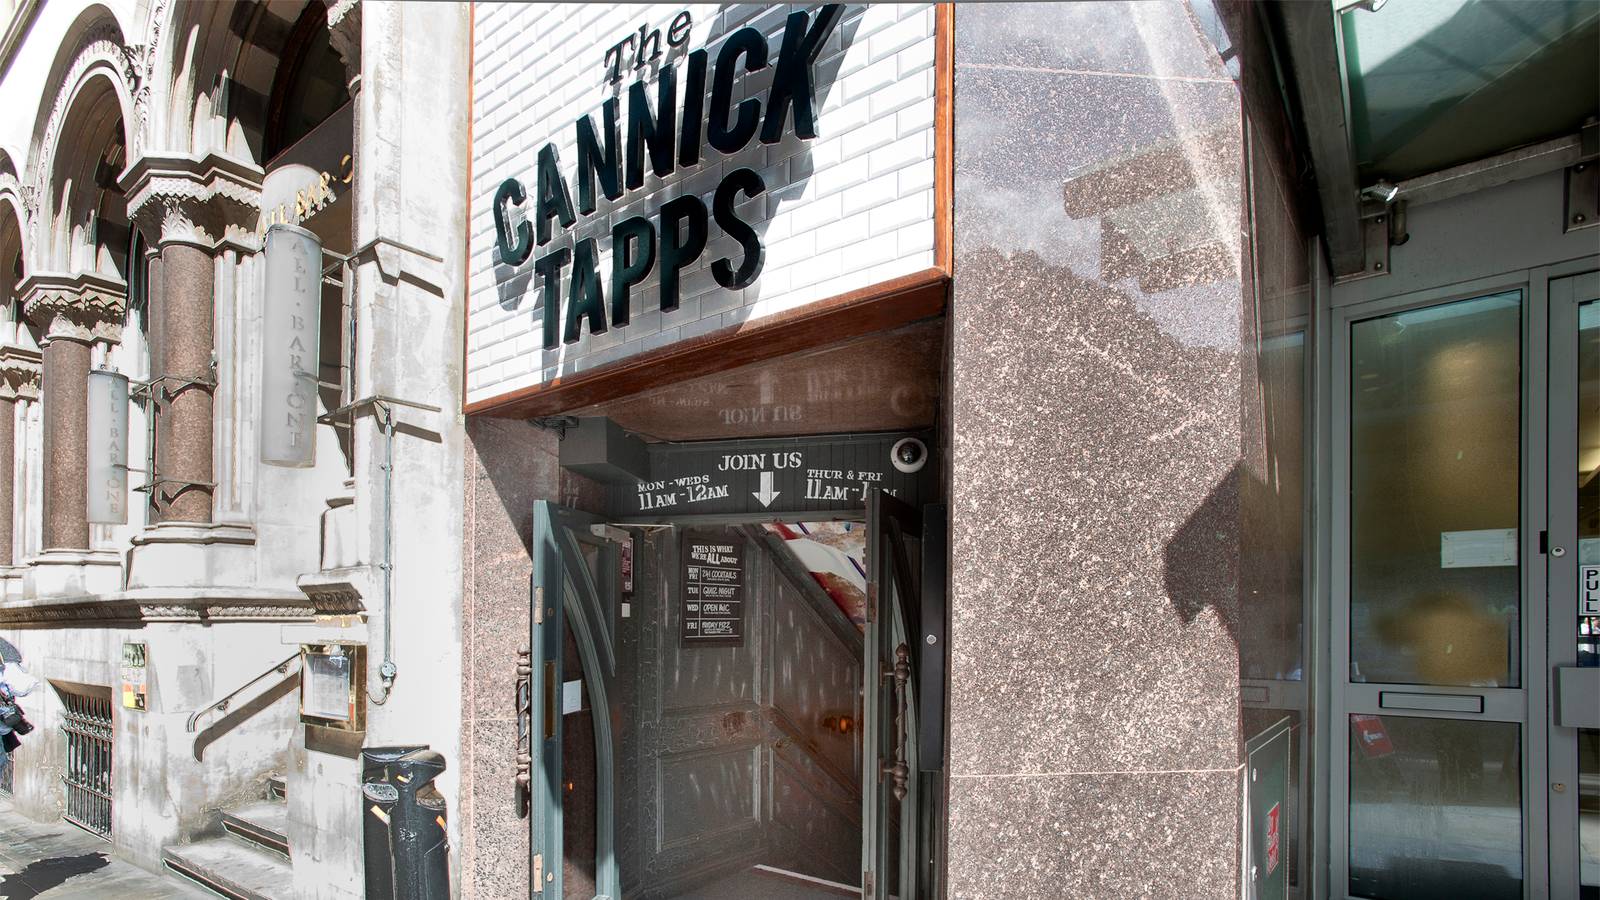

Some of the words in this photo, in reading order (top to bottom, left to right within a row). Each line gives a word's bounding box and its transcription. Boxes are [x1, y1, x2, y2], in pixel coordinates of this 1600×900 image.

[604, 10, 693, 86] The
[493, 3, 848, 267] CANNICK
[534, 167, 766, 351] TAPPS
[718, 453, 766, 471] JOIN
[772, 452, 802, 469] US
[807, 469, 843, 479] THUR
[847, 470, 854, 480] &
[858, 472, 883, 481] FRI
[637, 481, 665, 492] MON
[692, 545, 709, 553] THIS
[709, 545, 716, 553] IS
[716, 545, 733, 553] WHAT
[706, 552, 720, 565] ALL
[1586, 569, 1599, 613] PULL
[687, 622, 698, 630] FRI
